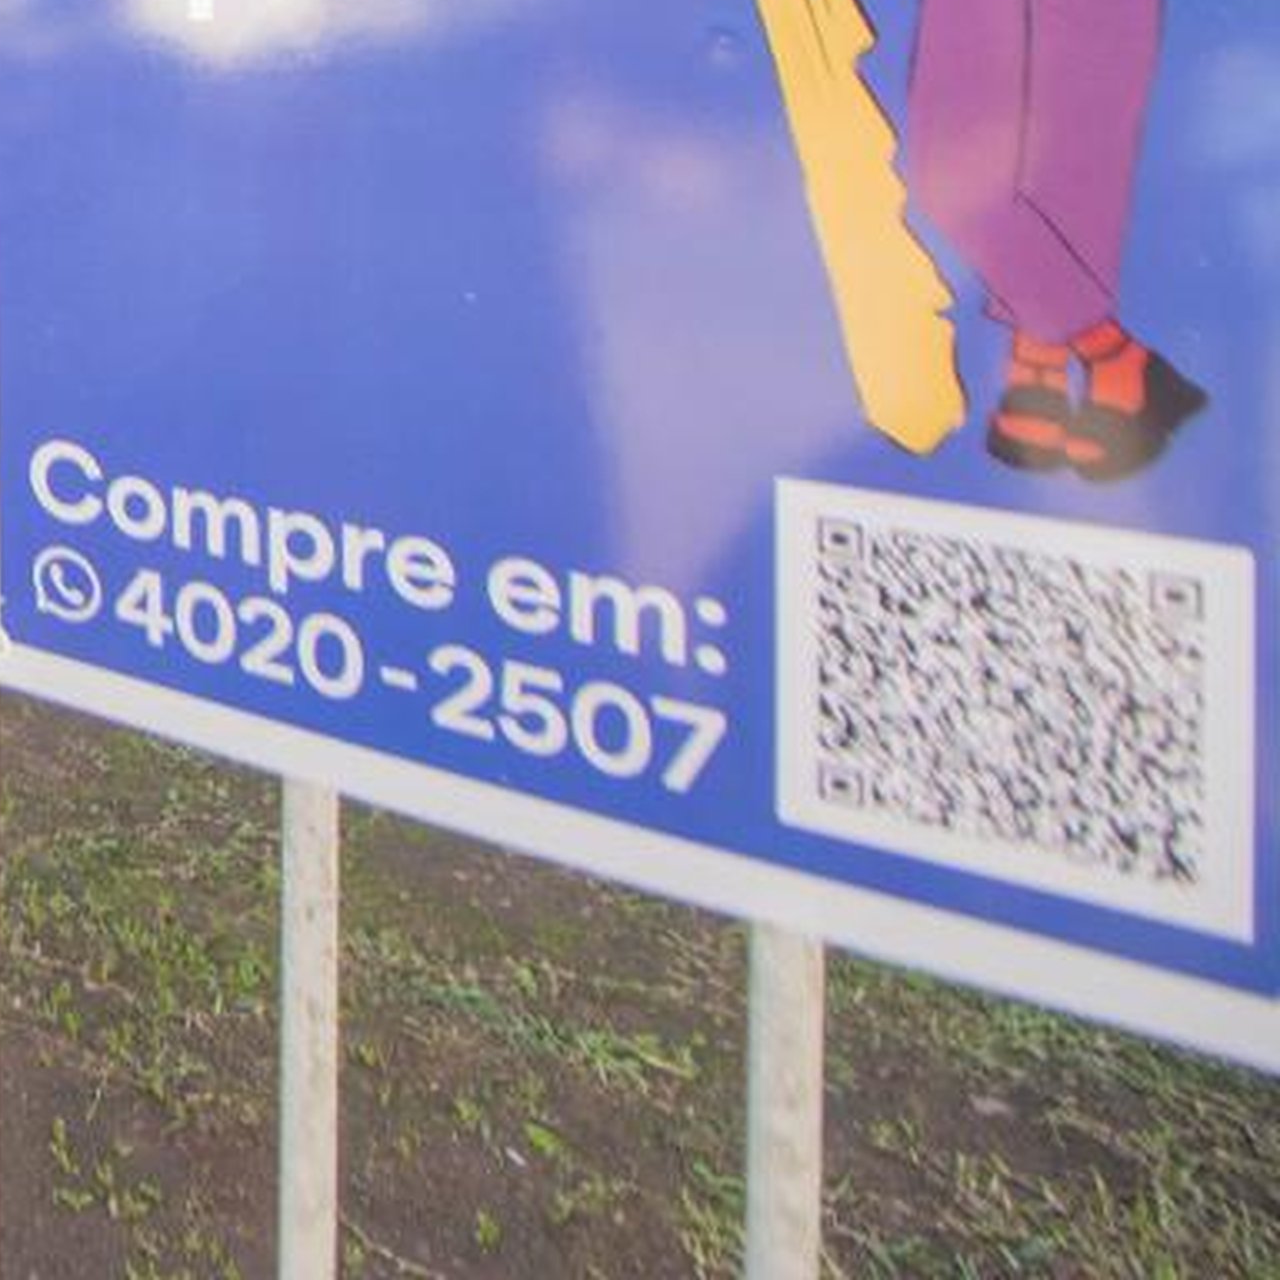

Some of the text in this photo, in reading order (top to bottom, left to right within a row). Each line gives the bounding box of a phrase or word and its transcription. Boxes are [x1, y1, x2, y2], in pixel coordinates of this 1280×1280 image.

[29, 439, 728, 675] Compre em:
[113, 569, 727, 793] 4020-2507
